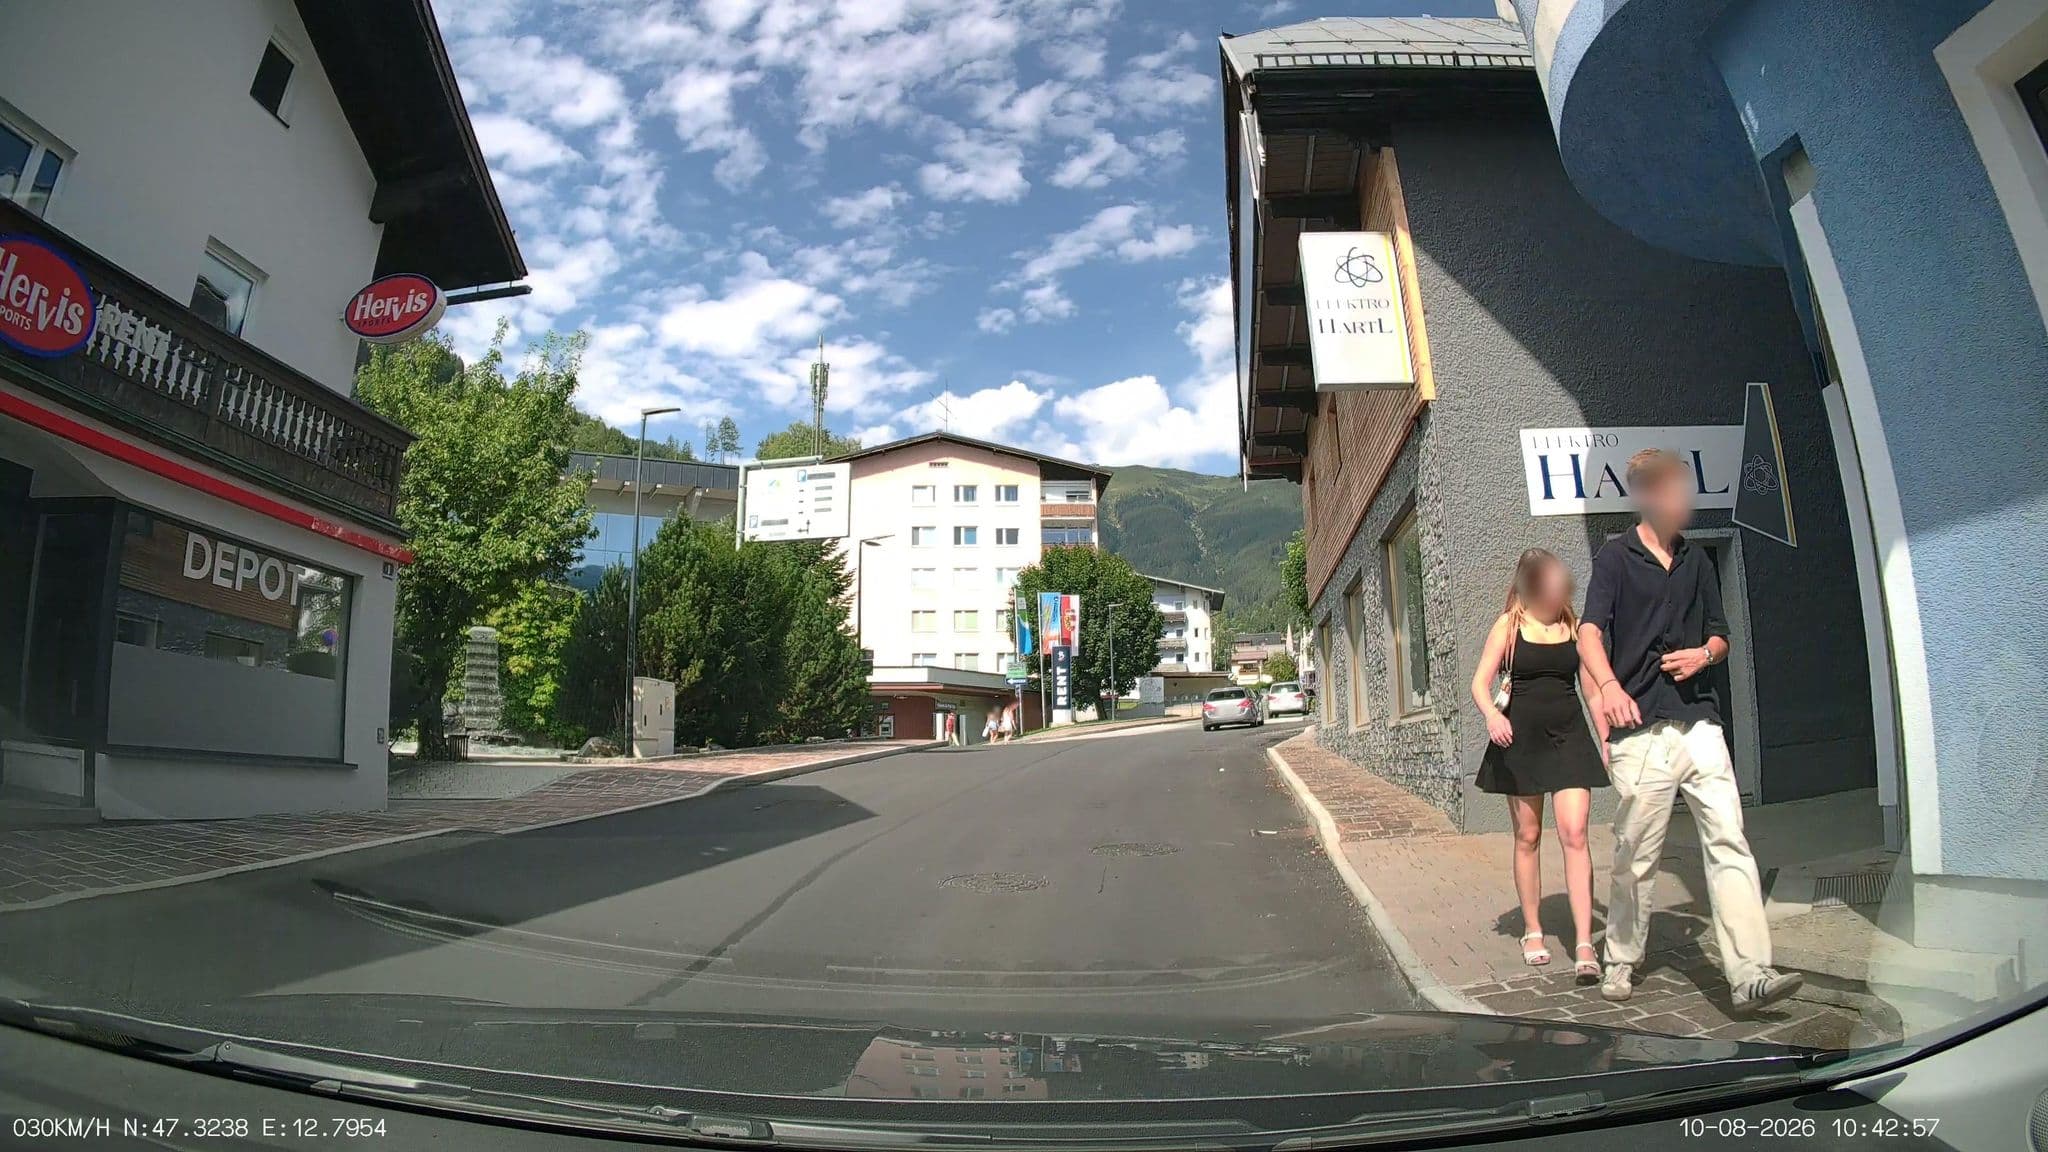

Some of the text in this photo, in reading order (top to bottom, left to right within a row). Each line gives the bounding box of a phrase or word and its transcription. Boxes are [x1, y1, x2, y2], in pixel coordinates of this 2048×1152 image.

[0, 247, 84, 335] Hervis
[353, 289, 428, 321] Hervis
[0, 305, 32, 331] PORTS
[1319, 318, 1393, 334] HARTL
[1533, 433, 1619, 449] ELEKTRO
[1538, 449, 1730, 500] HAL
[183, 531, 306, 606] DEPOT
[1056, 667, 1067, 706] RENT
